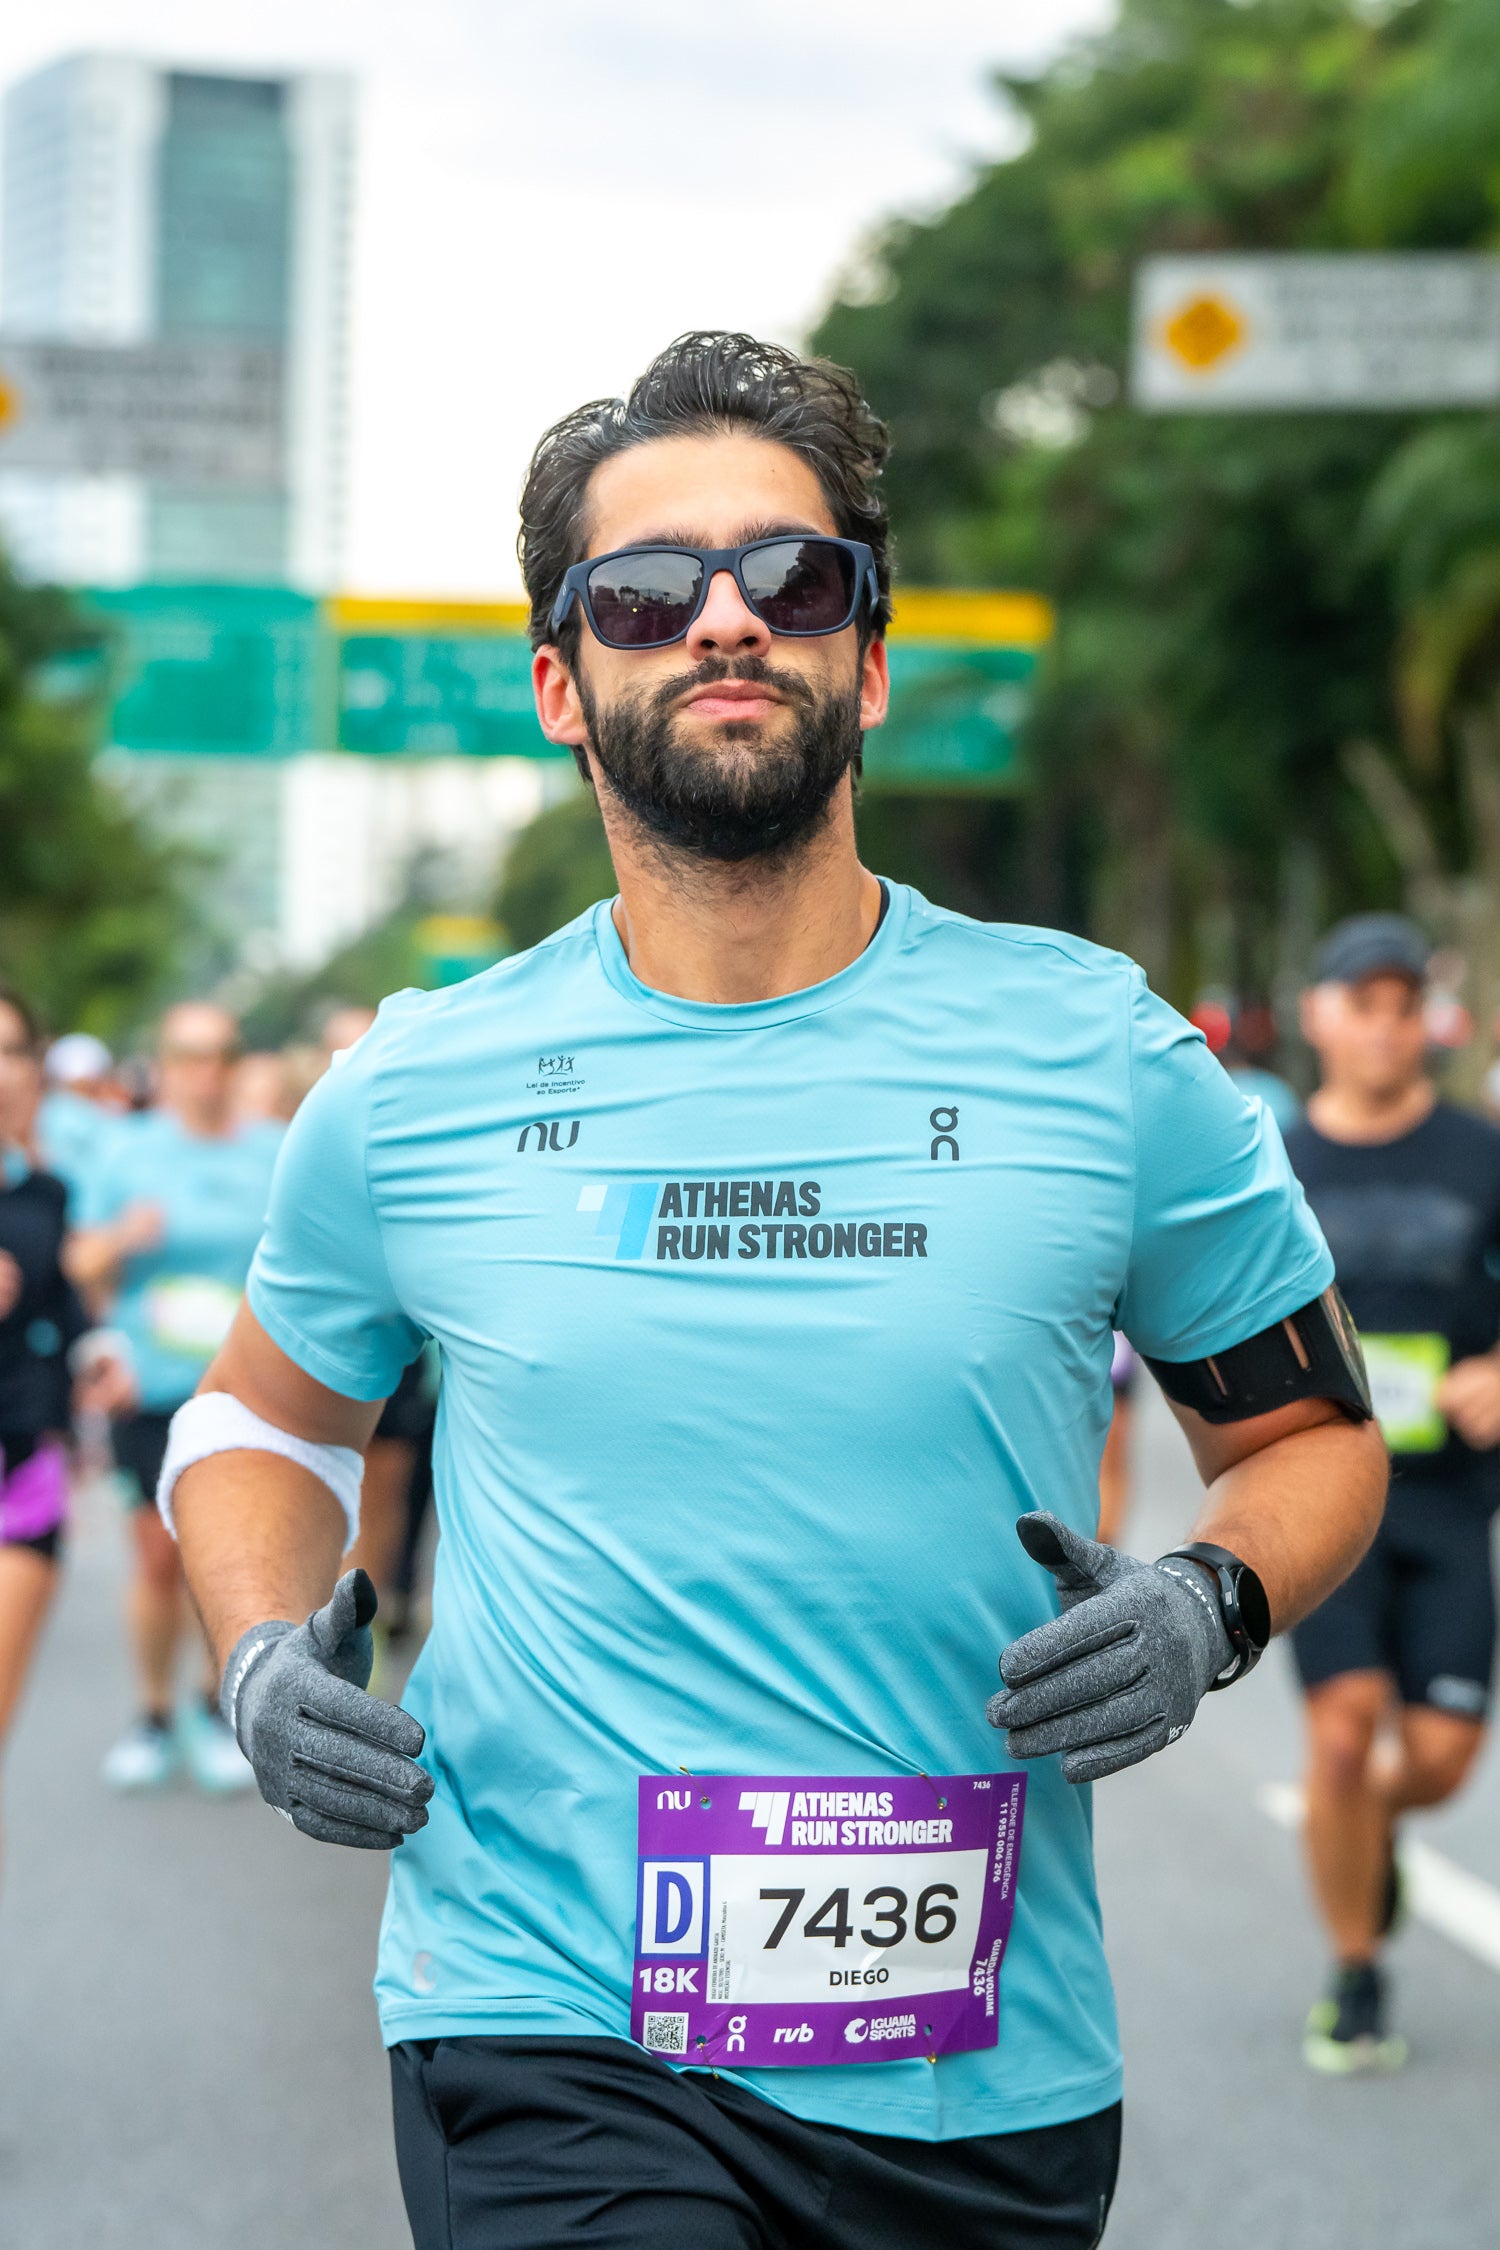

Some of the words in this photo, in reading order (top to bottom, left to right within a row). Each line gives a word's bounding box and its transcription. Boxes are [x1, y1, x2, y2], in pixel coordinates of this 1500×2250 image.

[658, 1181, 821, 1218] ATHENAS
[656, 1224, 730, 1260] RUN
[738, 1222, 928, 1260] STRONGER
[973, 1781, 991, 1790] 7436
[791, 1792, 893, 1817] ATHENAS
[1000, 1802, 1008, 1814] 11
[1008, 1783, 1019, 1827] TELEFONE
[791, 1820, 838, 1846] RUN
[841, 1819, 953, 1846] STRONGER
[998, 1817, 1007, 1838] 955
[1007, 1829, 1015, 1841] DE
[995, 1840, 1005, 1860] 006
[993, 1862, 1002, 1883] 296
[1001, 1842, 1014, 1900] EMERGÊNCIA
[655, 1871, 693, 1944] D
[759, 1882, 959, 1950] 7436
[639, 1967, 699, 1993] 18K
[829, 1967, 889, 1987] DIEGO
[973, 1958, 988, 1997] 7436
[986, 1938, 1002, 2017] GUARDA-VOLUME
[773, 2023, 814, 2043] rvb
[869, 2026, 916, 2041] SPORTS
[870, 2014, 916, 2029] IGUANA
